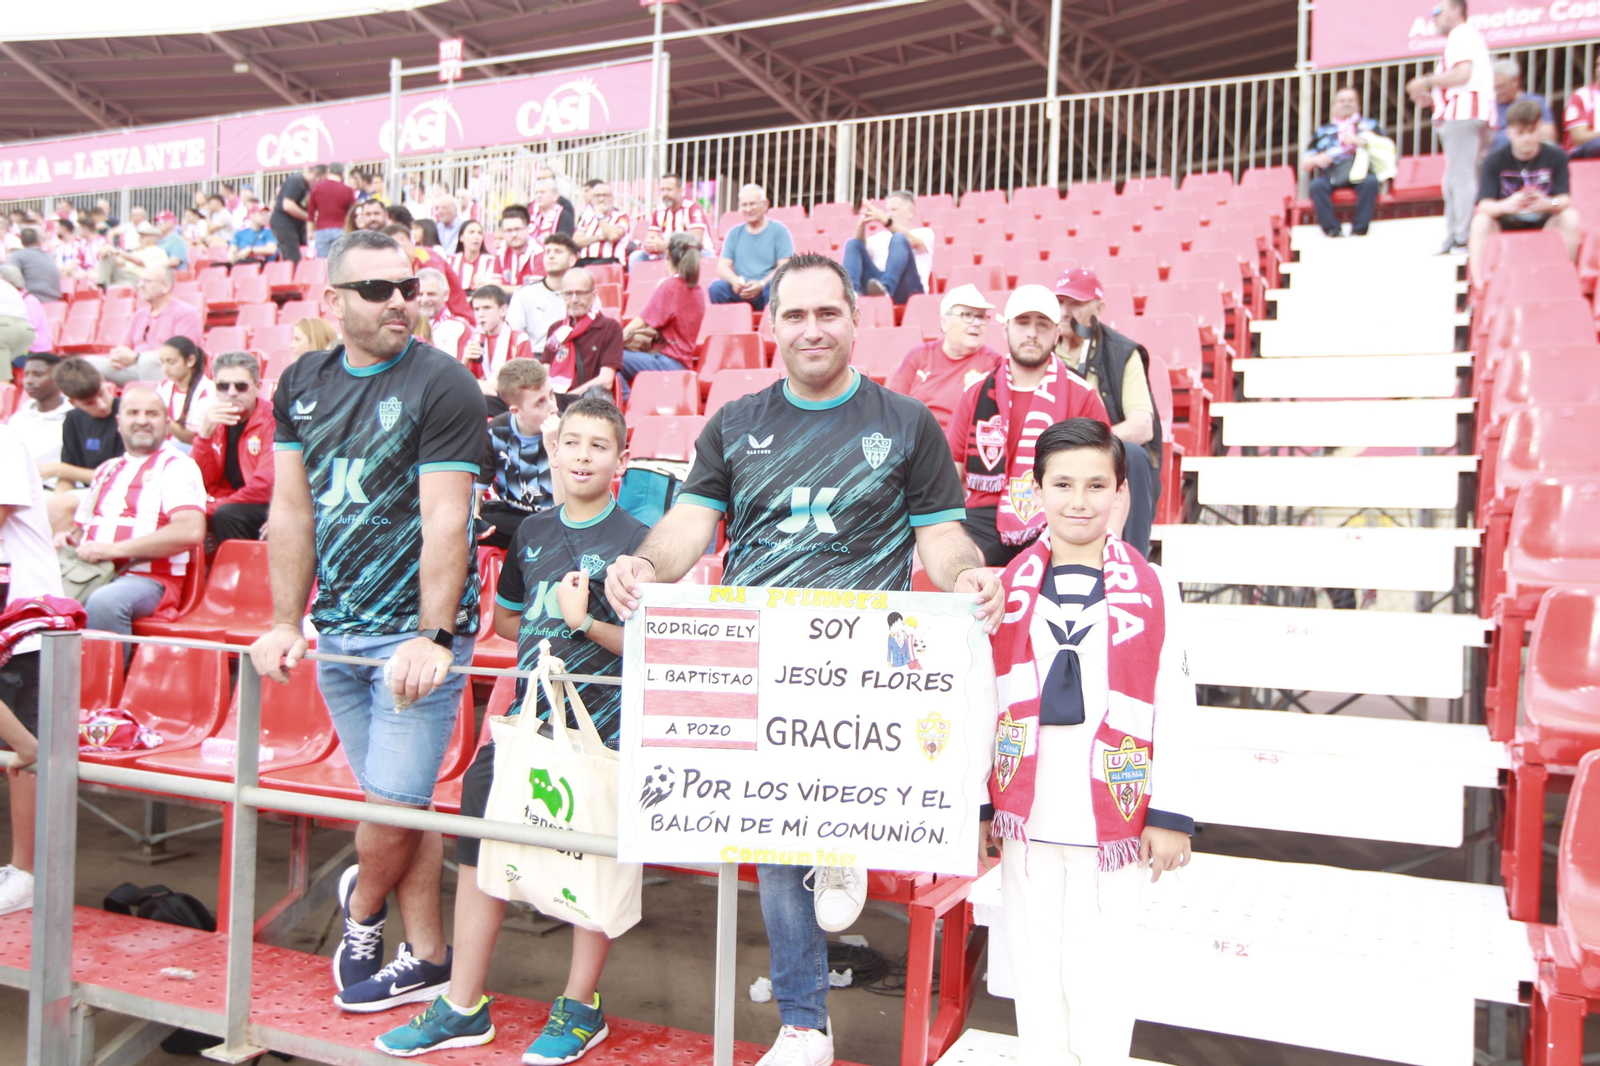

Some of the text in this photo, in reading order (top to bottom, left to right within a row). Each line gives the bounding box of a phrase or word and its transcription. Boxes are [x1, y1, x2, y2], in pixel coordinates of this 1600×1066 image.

[516, 94, 591, 137] CASI
[257, 130, 319, 167] CASI
[379, 112, 447, 153] CASI
[0, 156, 52, 187] LLA
[74, 138, 206, 180] LEVANTE
[317, 457, 370, 507] JK
[775, 487, 841, 534] JK
[831, 541, 851, 554] Co.
[646, 620, 756, 639] RODRIGO ELY
[808, 616, 861, 640] SOY
[665, 668, 753, 686] BAPTISTAO
[775, 660, 954, 693] JESÚS FLORES
[687, 723, 731, 737] POZO
[766, 714, 902, 752] GRACIAS
[743, 780, 788, 801] LOS
[797, 778, 888, 806] VIDEOS
[896, 785, 912, 806] Y
[921, 790, 952, 809] EL
[650, 810, 731, 833] BALÓN
[740, 817, 774, 834] DE
[817, 820, 948, 844] COMUNIÓN.
[720, 845, 856, 868] Comunión
